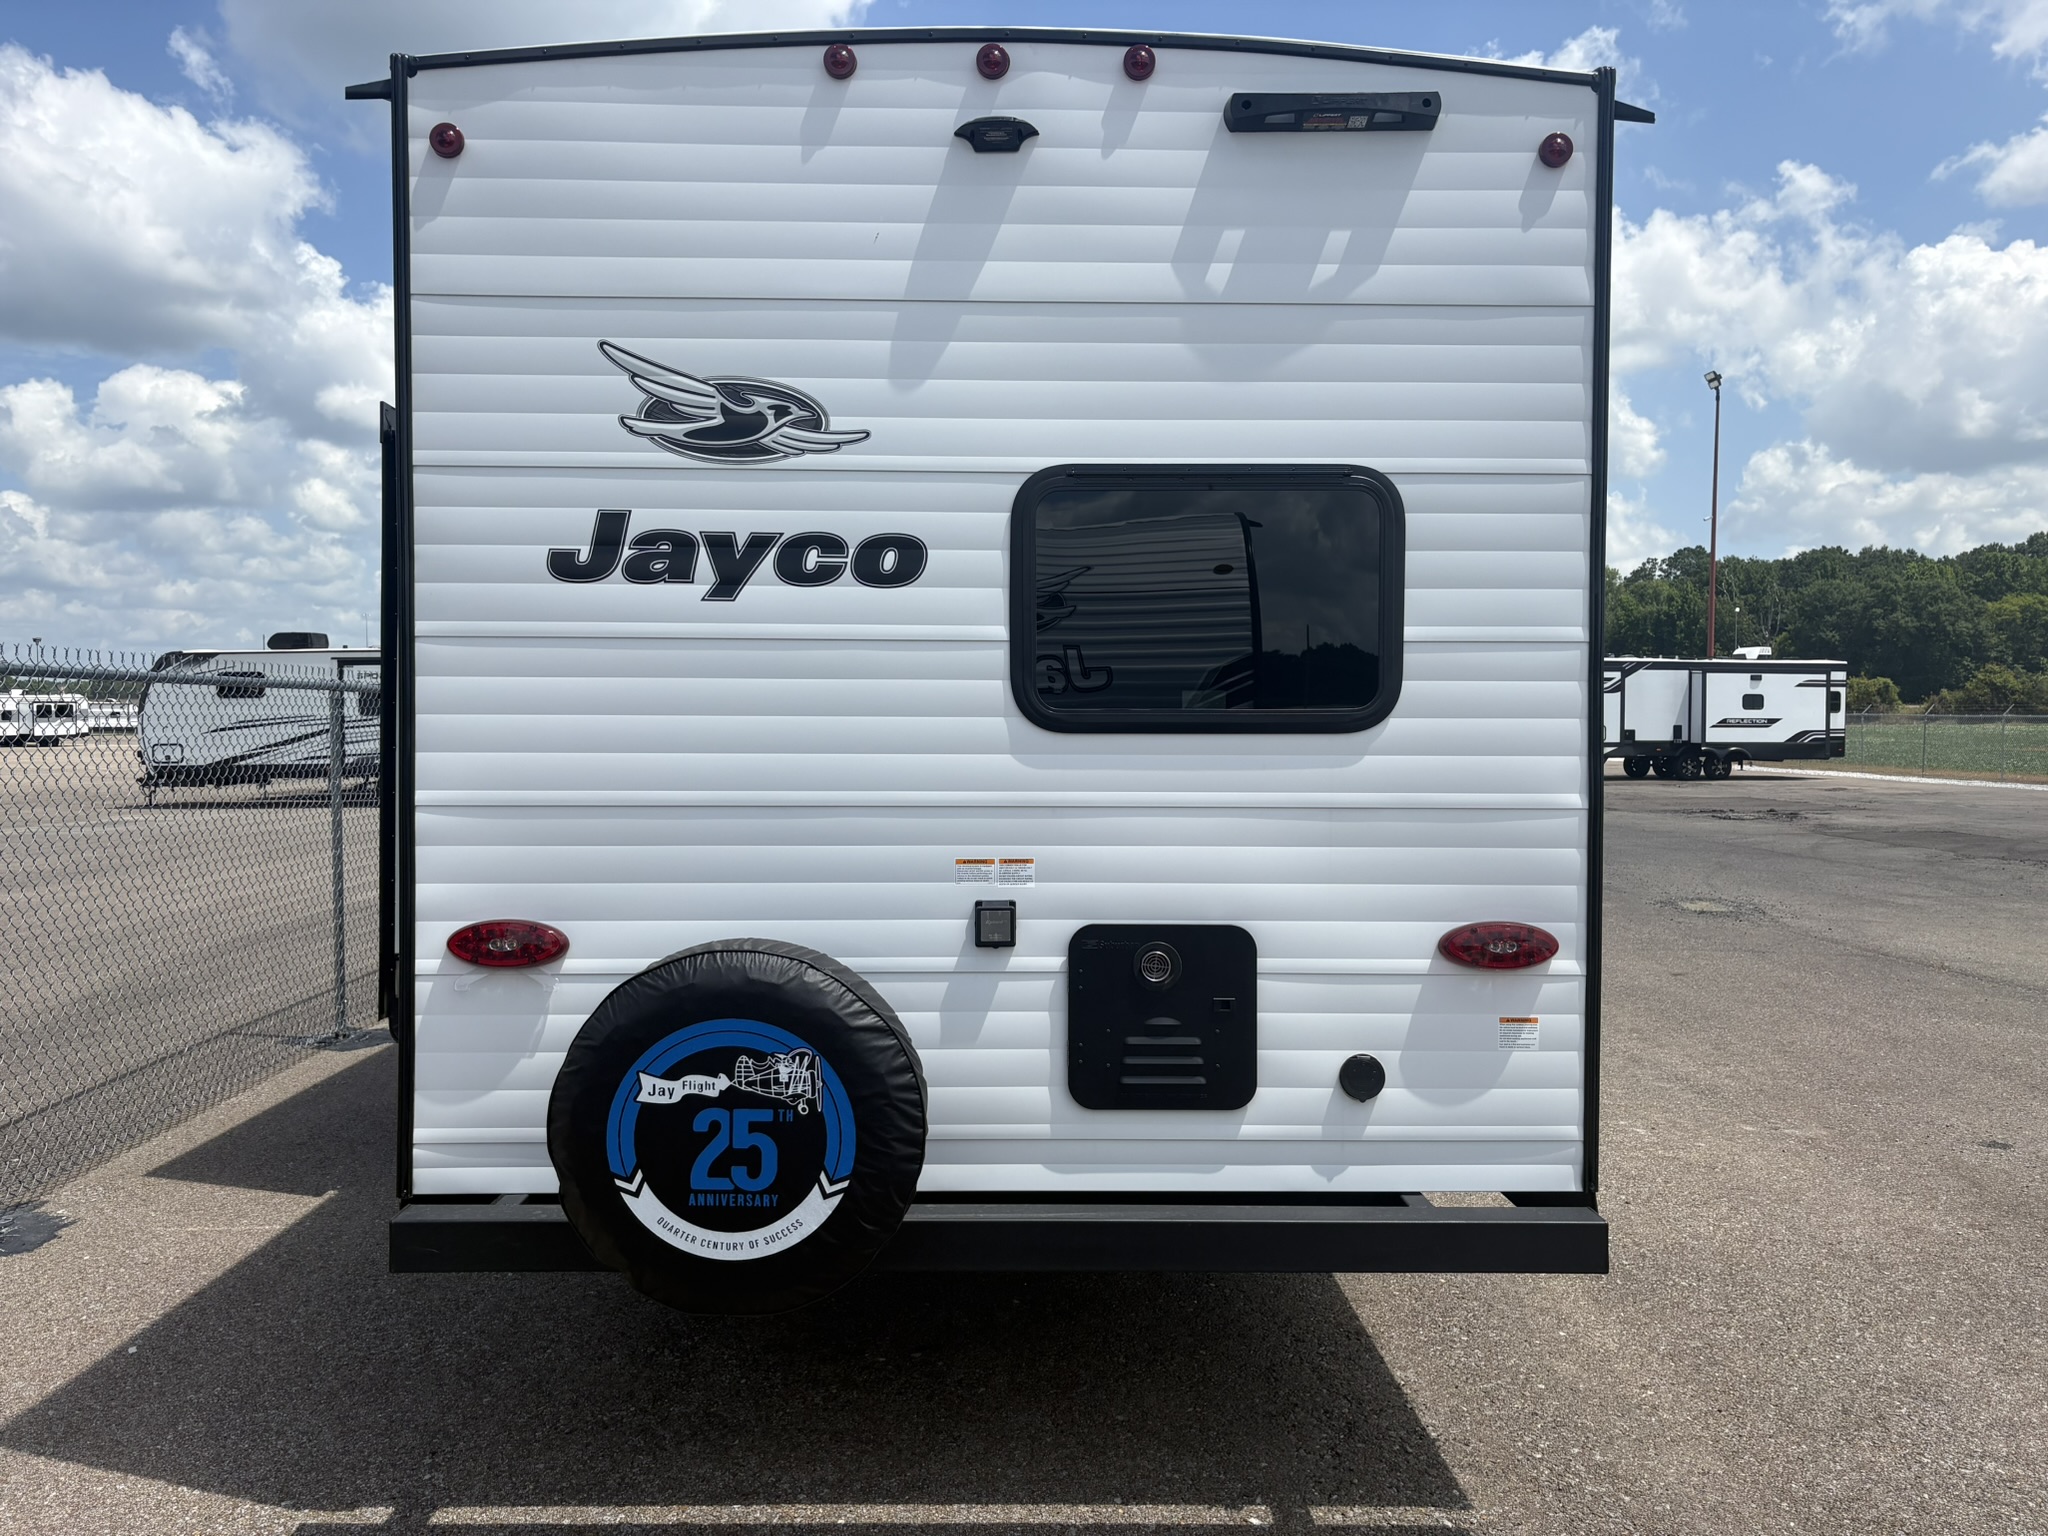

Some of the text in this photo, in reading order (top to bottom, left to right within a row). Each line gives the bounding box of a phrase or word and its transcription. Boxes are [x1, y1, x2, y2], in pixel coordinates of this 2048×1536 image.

[547, 510, 928, 601] Jayco
[648, 1080, 716, 1099] Jay Flight
[691, 1108, 793, 1191] 25 TH
[689, 1193, 779, 1207] ANNIVERSARY
[657, 1216, 804, 1251] QUARTER CENTURY OF SUCCESS
